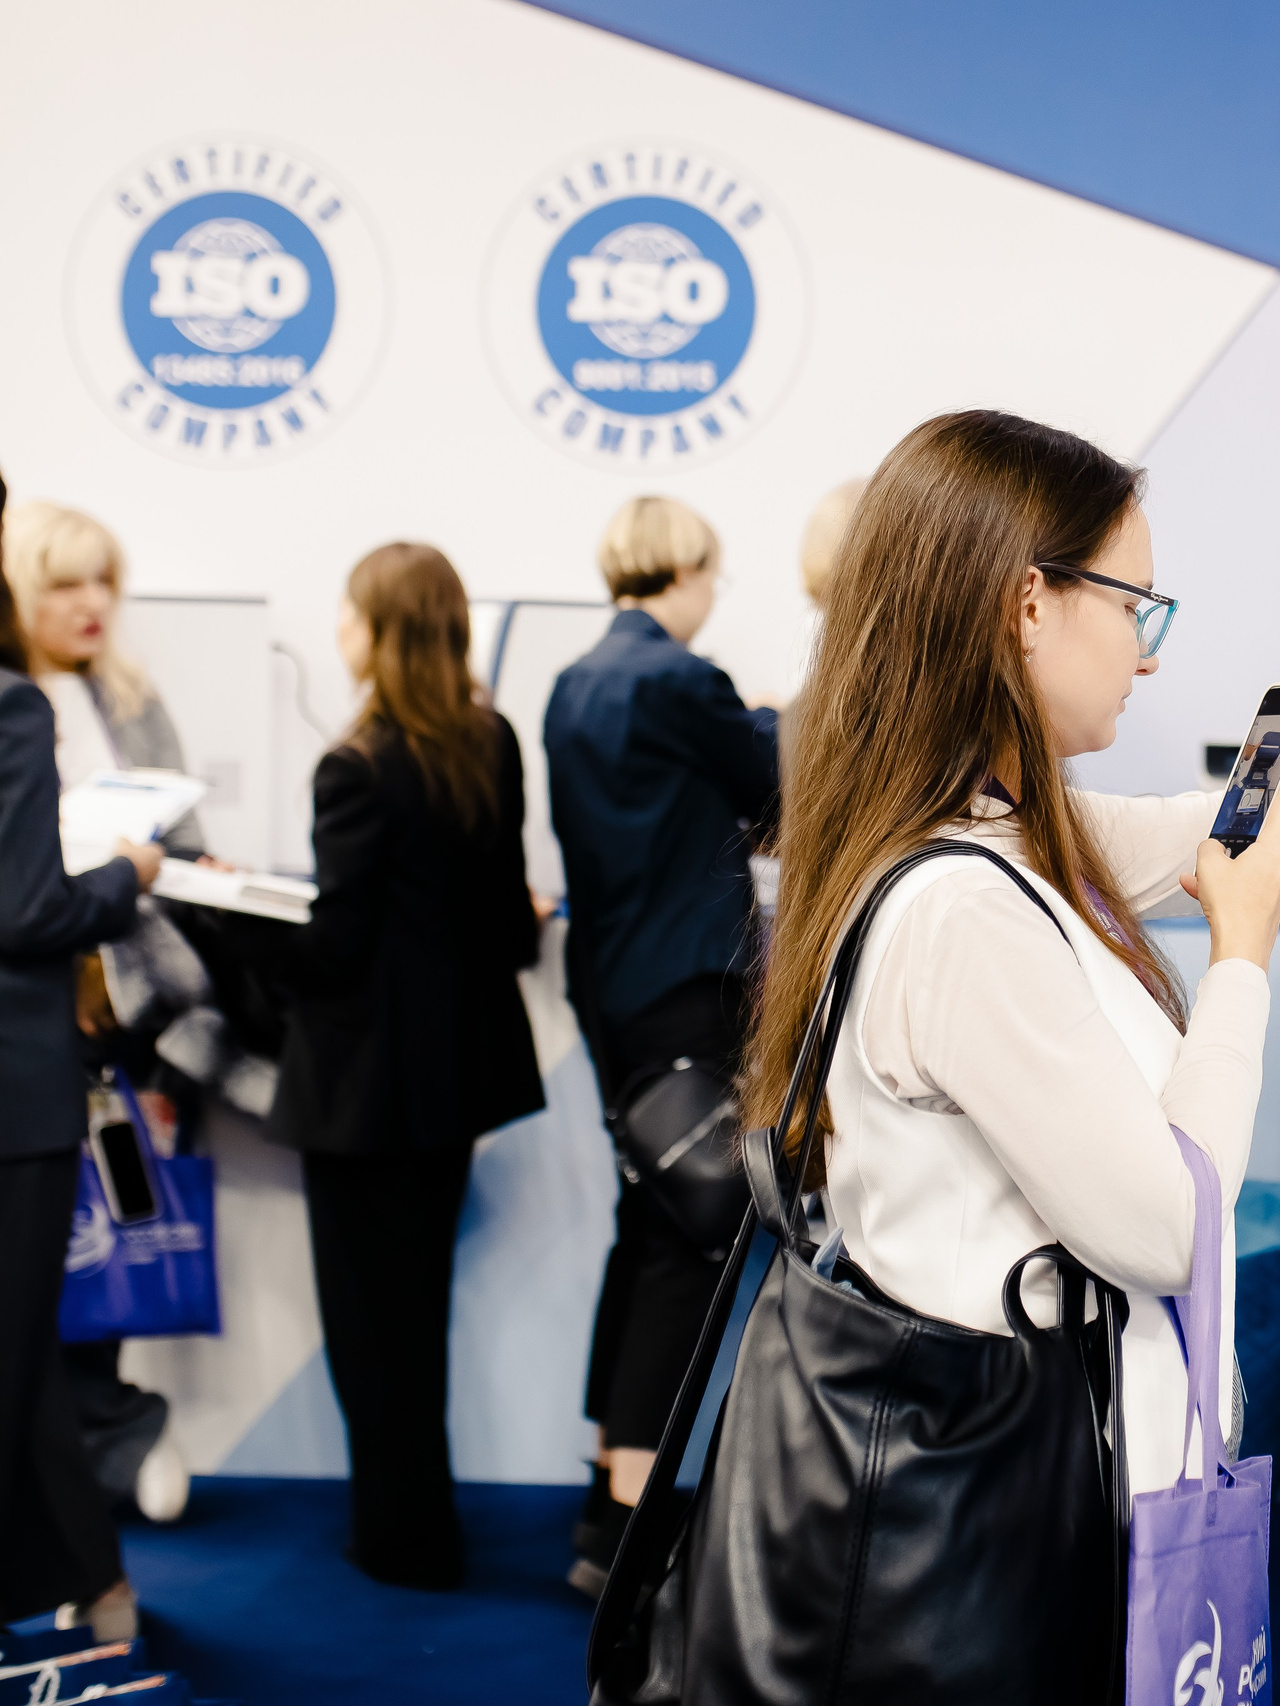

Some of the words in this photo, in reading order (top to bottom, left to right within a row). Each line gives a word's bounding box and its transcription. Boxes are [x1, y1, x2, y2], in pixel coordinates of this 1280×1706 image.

[150, 249, 311, 320] ISO
[567, 255, 729, 325] ISO
[116, 384, 329, 449] COMPANY
[534, 388, 750, 458] COMPANY
